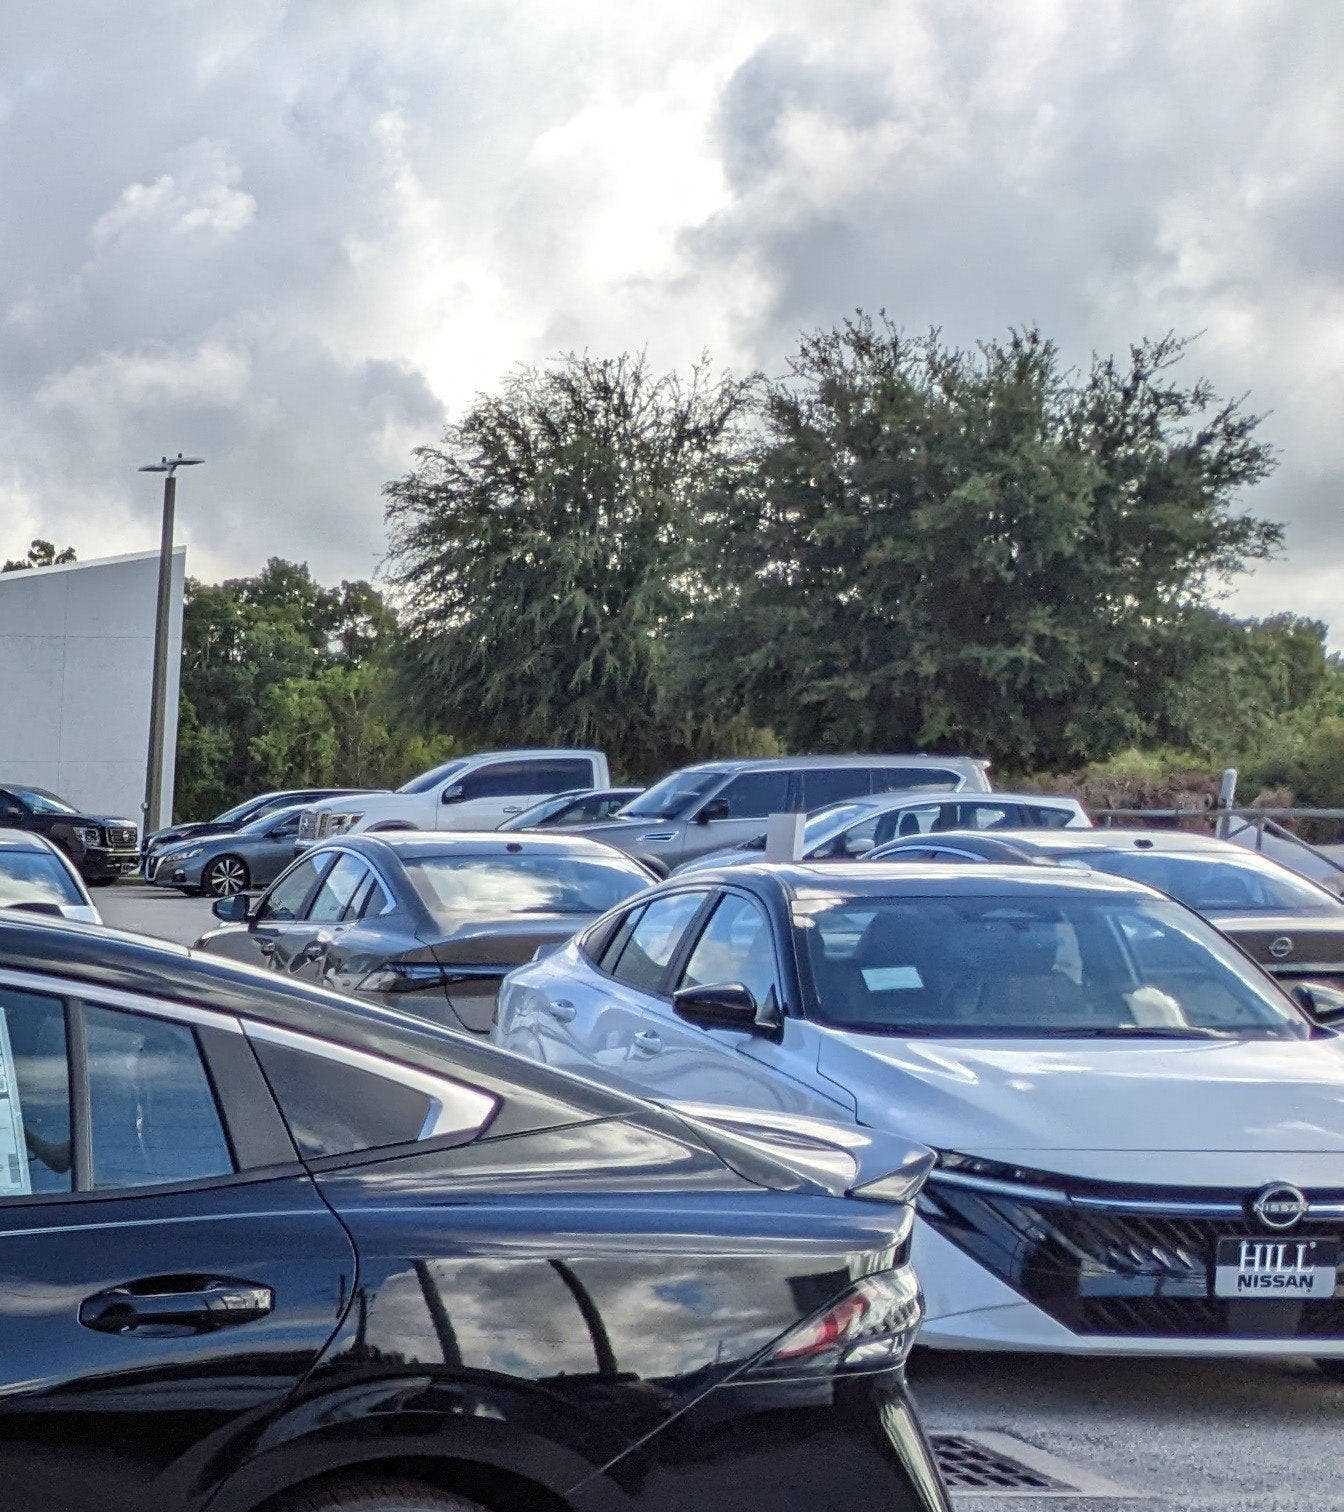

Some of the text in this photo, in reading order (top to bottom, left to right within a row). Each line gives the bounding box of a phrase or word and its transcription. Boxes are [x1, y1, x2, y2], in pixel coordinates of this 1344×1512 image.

[1253, 1201, 1309, 1213] NISSAN
[1238, 1243, 1314, 1273] HILL
[1237, 1274, 1314, 1288] NISSAN
